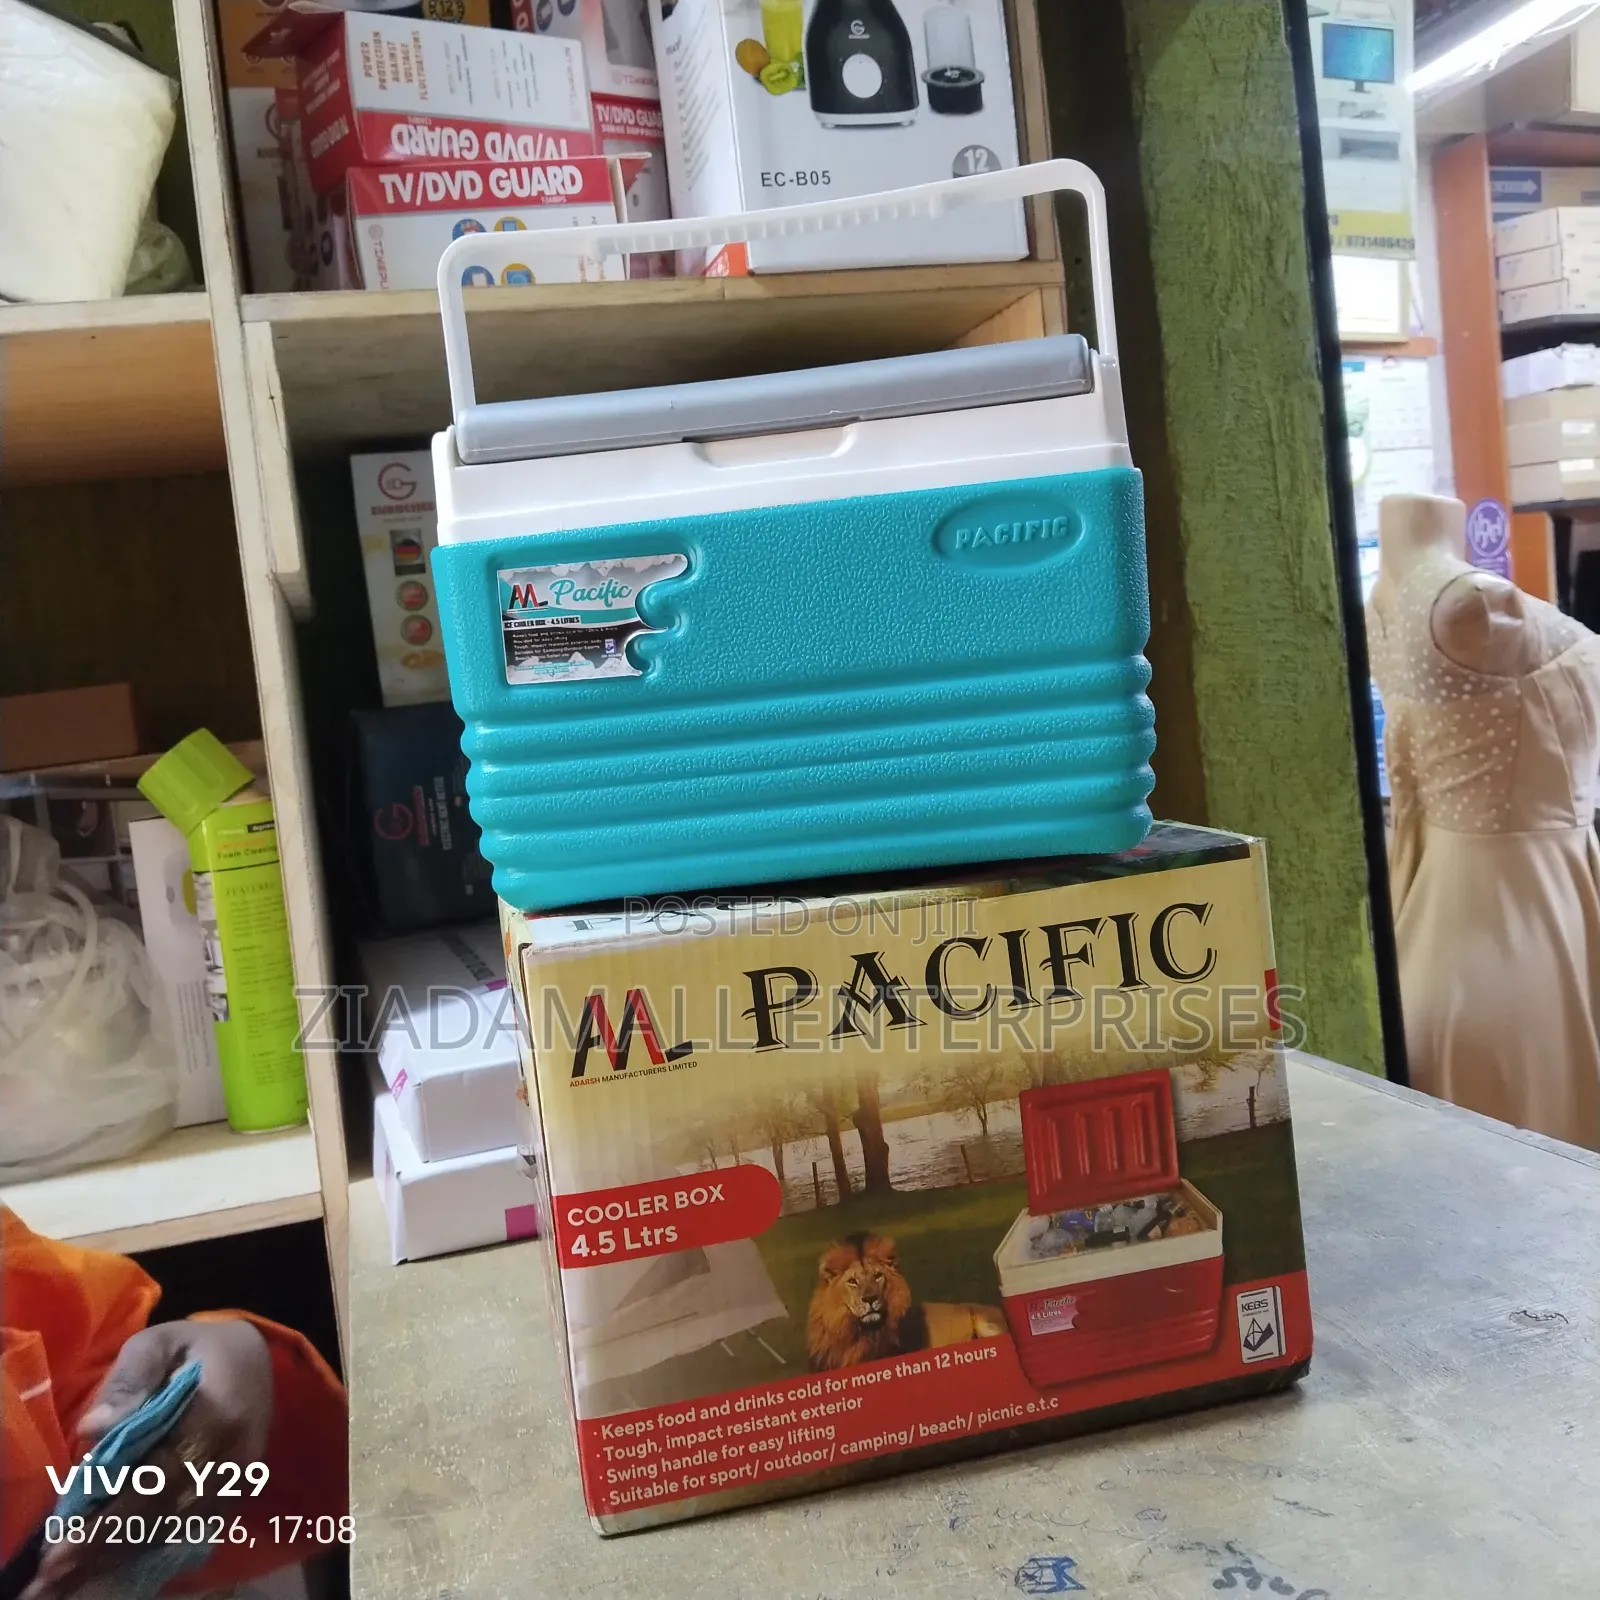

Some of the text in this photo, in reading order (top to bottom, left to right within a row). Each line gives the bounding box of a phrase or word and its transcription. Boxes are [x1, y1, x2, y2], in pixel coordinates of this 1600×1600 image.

[391, 124, 479, 160] GUARD
[761, 170, 831, 188] EC-B05
[964, 148, 989, 174] 12
[379, 165, 583, 206] TV/DVD GUARD
[955, 516, 1068, 549] PACIFIC
[549, 578, 633, 607] Pacific
[741, 902, 1218, 1055] PACIFIC
[569, 1061, 698, 1088] ADARSH MANUFACTURERS LIMITED
[567, 1183, 725, 1226] COOLER BOX
[571, 1225, 678, 1258] 4.5 Ltrs
[1241, 1298, 1269, 1313] KEBS
[601, 1346, 998, 1440] Keeps food and drinks cold for more than 12 hours
[603, 1396, 863, 1462] Tough, impact resistant exterior
[606, 1424, 835, 1484] Swing handle for easy lifting
[609, 1396, 1059, 1506] Suitable for sport/ outdoor/ camping/ beach/ picnic e.t.c
